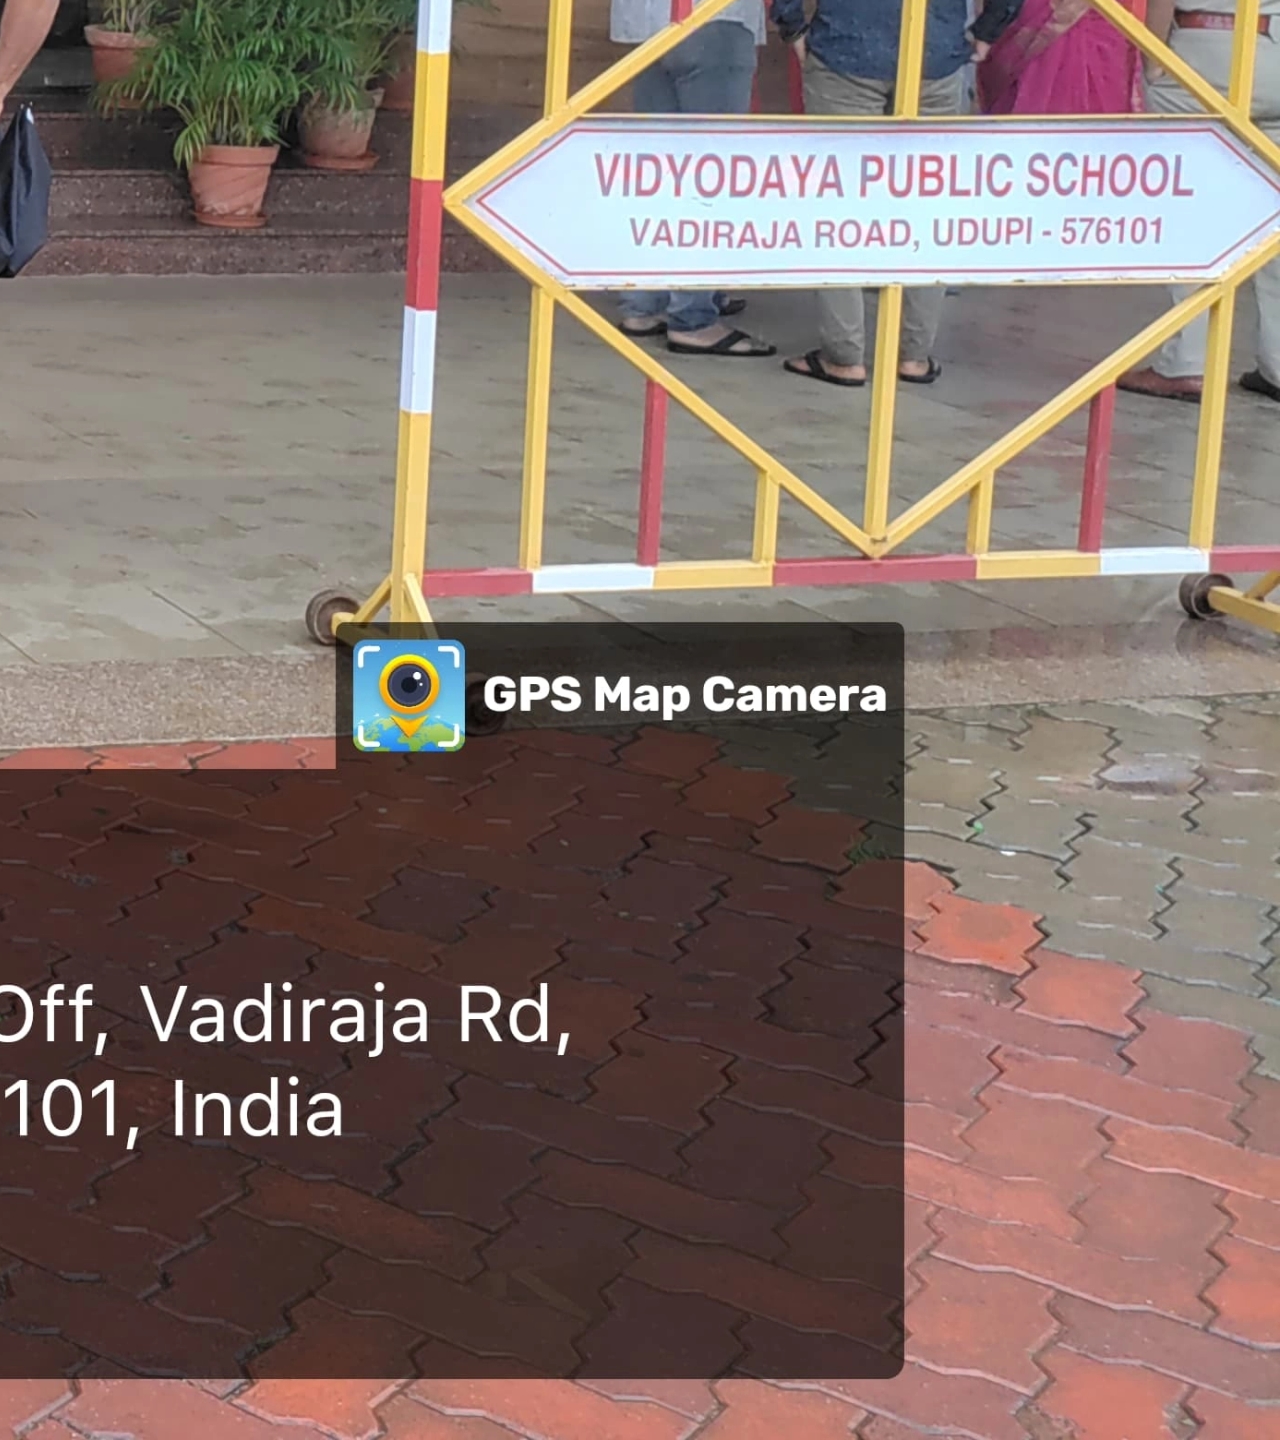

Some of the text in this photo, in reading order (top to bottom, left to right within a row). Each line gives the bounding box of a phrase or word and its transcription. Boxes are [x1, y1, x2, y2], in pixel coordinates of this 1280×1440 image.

[595, 152, 1194, 199] VIDYODAYA PUBLIC SCHOOL
[630, 218, 803, 249] VADIRAJA
[815, 218, 920, 252] ROAD,
[932, 216, 1034, 247] UDUPI
[1061, 216, 1164, 246] 576101
